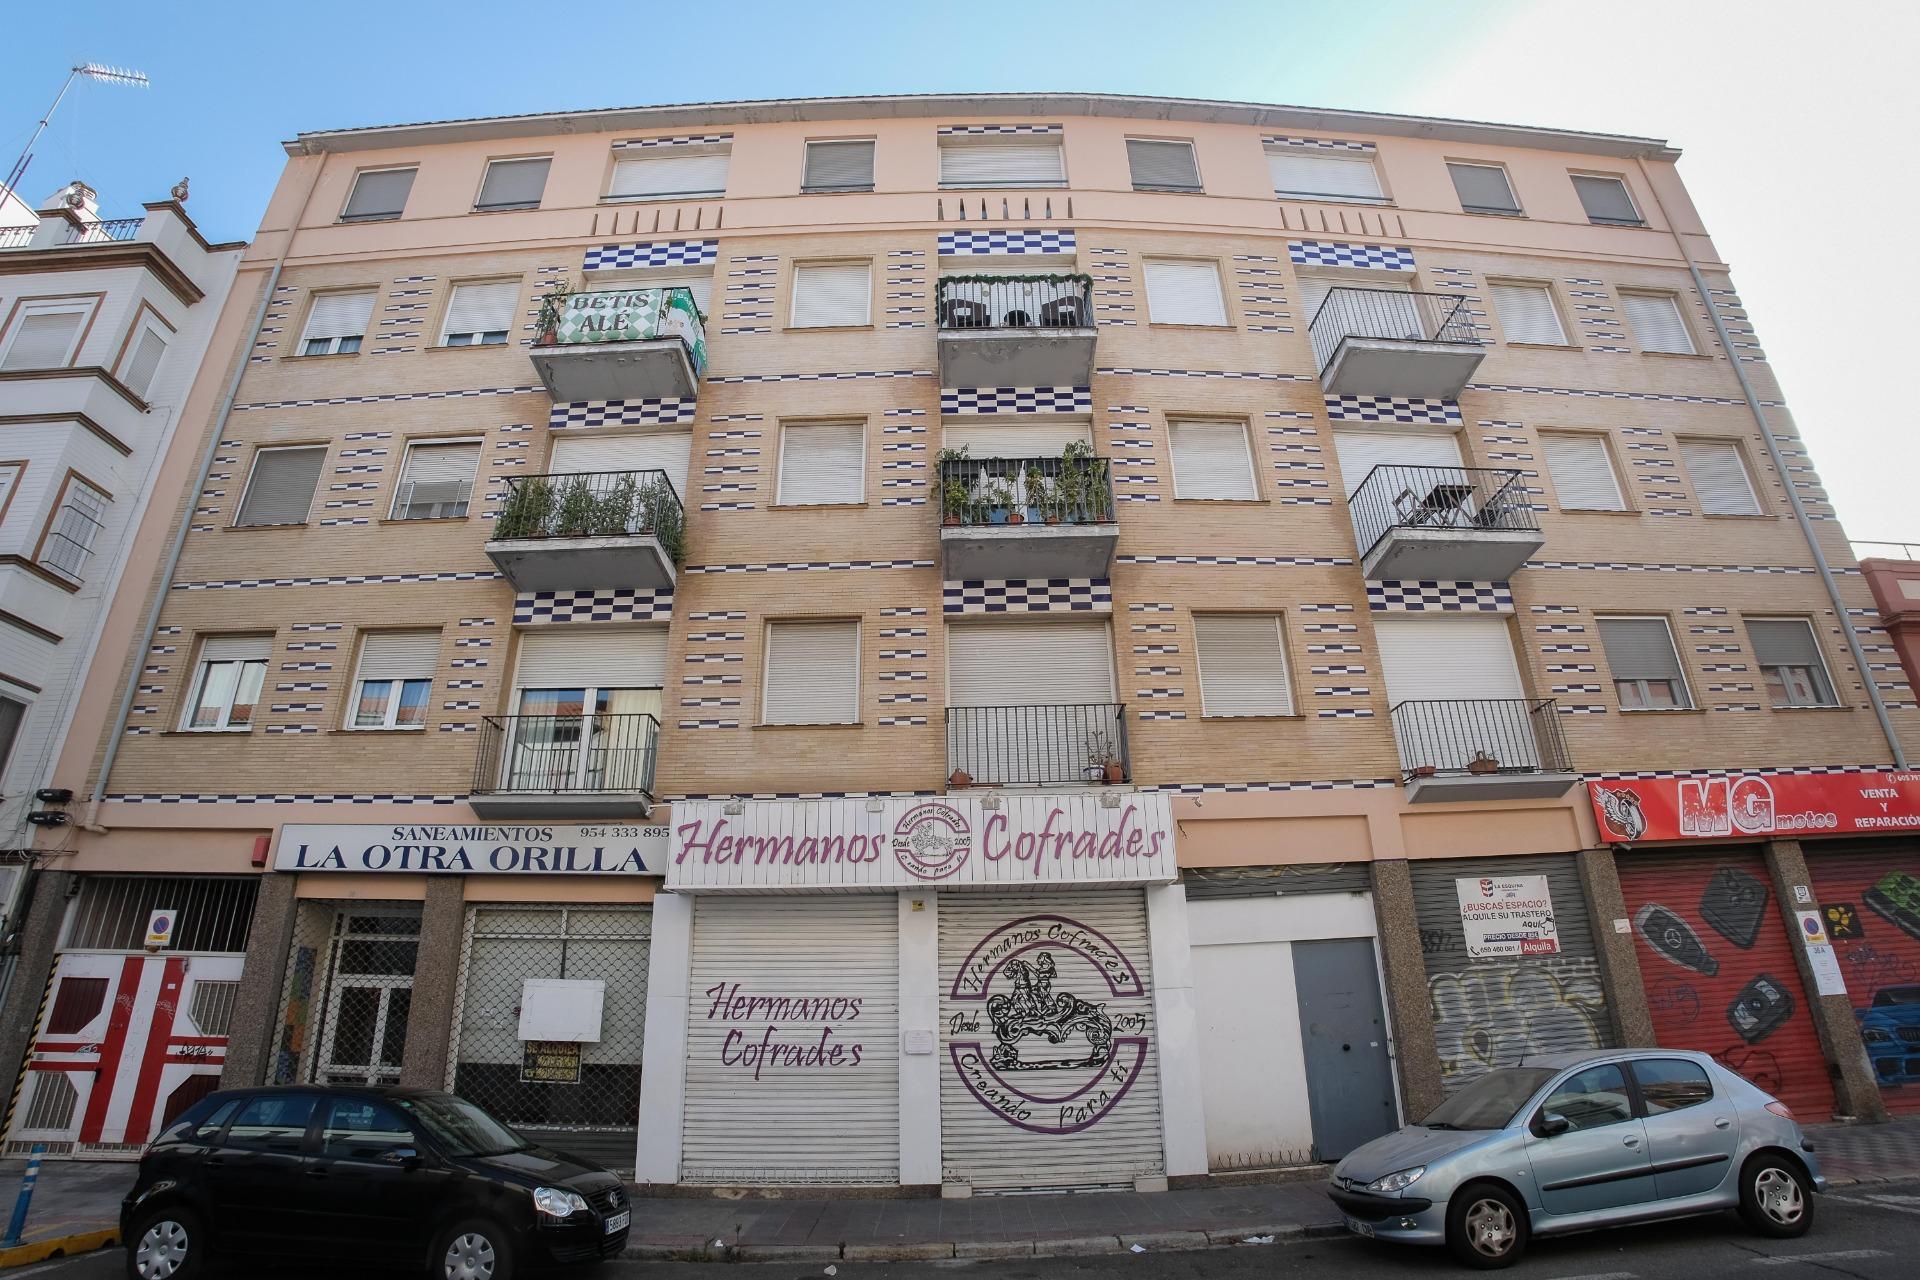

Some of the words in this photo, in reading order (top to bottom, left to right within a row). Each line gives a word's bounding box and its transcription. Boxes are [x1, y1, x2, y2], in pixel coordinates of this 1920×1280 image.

[573, 293, 650, 310] BETIS
[579, 309, 630, 332] ALÉ
[1860, 788, 1899, 799] VENTA
[1677, 776, 1774, 837] MG
[1879, 802, 1888, 812] Y
[902, 808, 933, 830] Hermanos
[1776, 811, 1837, 829] motos
[391, 826, 554, 843] SANEAMIENTOS
[580, 827, 606, 838] 954
[611, 827, 640, 838] 333
[642, 827, 670, 838] 895
[675, 818, 886, 866] Hermanos
[982, 804, 1167, 877] Cofrades
[954, 836, 971, 847] 2005
[295, 844, 348, 869] LA
[361, 845, 474, 871] OTRA
[489, 845, 650, 872] ORILLA
[1463, 902, 1504, 913] ¿BUSCAS
[1506, 900, 1547, 910] ESPACIO?
[1463, 912, 1497, 921] ALQUILE
[1510, 909, 1552, 918] TRASTERO
[1524, 941, 1552, 952] Alquila
[962, 928, 1041, 992] Hermanos
[1047, 923, 1130, 985] Cofrades
[705, 981, 863, 1021] Hermanos
[949, 1009, 982, 1036] Desde
[1112, 1013, 1146, 1036] 2005
[721, 1024, 864, 1081] Cofrades
[961, 1053, 1032, 1121] Creando
[1059, 1090, 1111, 1128] para
[1109, 1059, 1129, 1083] ti
